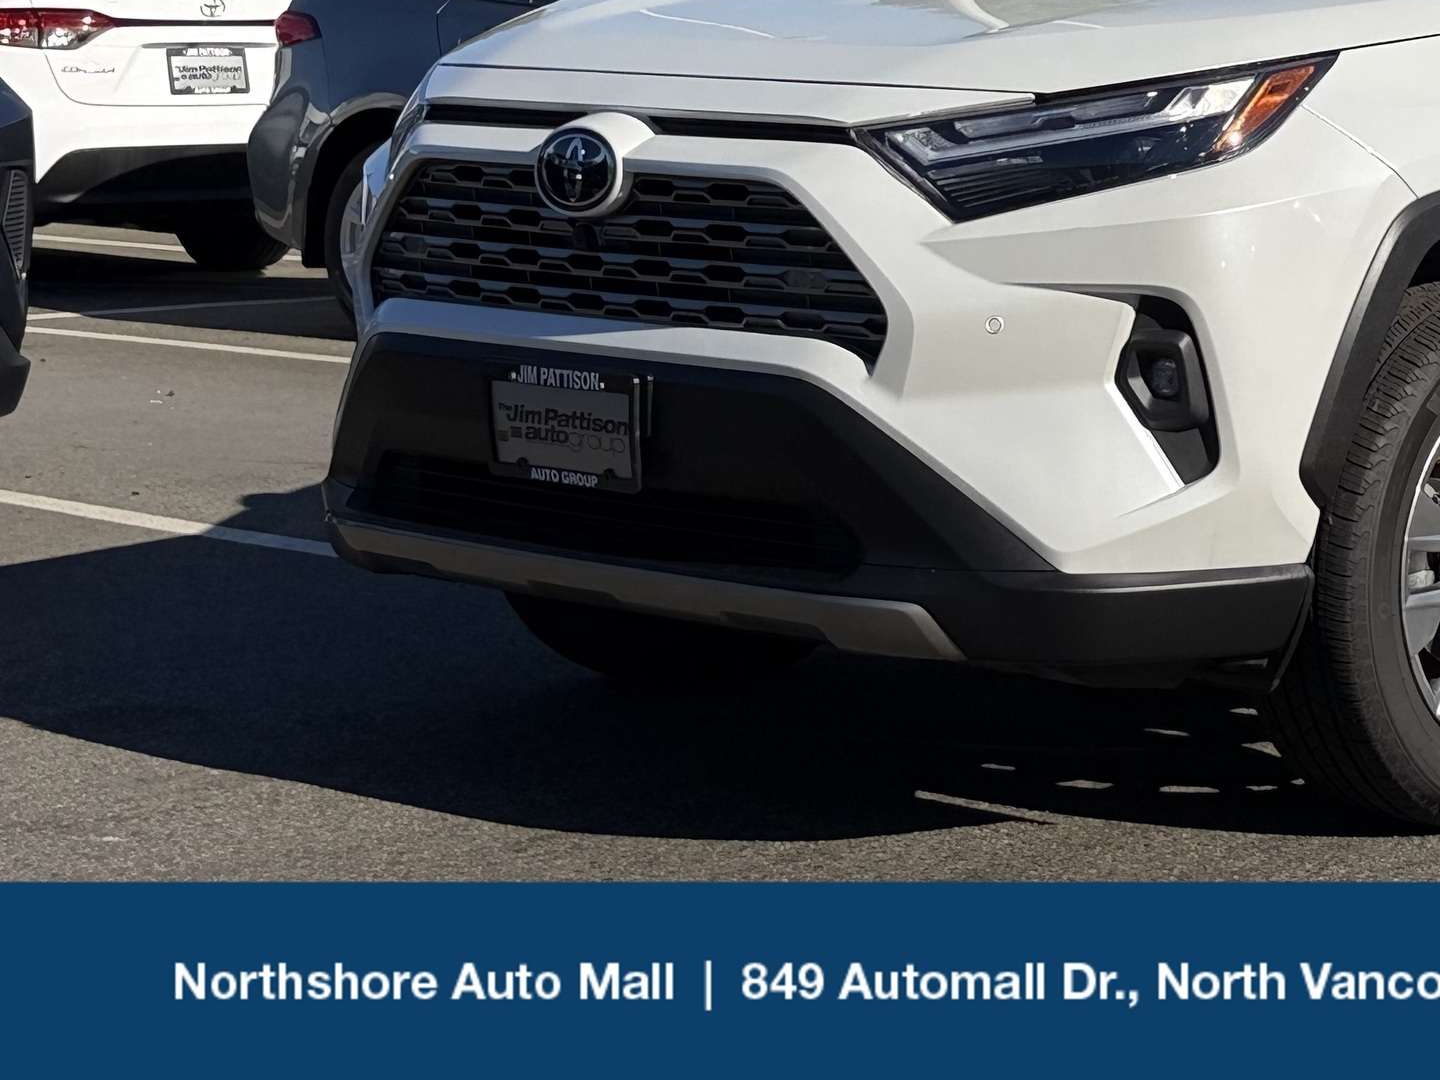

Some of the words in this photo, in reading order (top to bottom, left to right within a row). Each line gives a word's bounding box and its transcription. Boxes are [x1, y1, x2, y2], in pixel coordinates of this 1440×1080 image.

[517, 365, 538, 385] JIM
[540, 368, 600, 391] PATTISON
[530, 467, 560, 484] AUTO
[561, 471, 598, 488] GROUP
